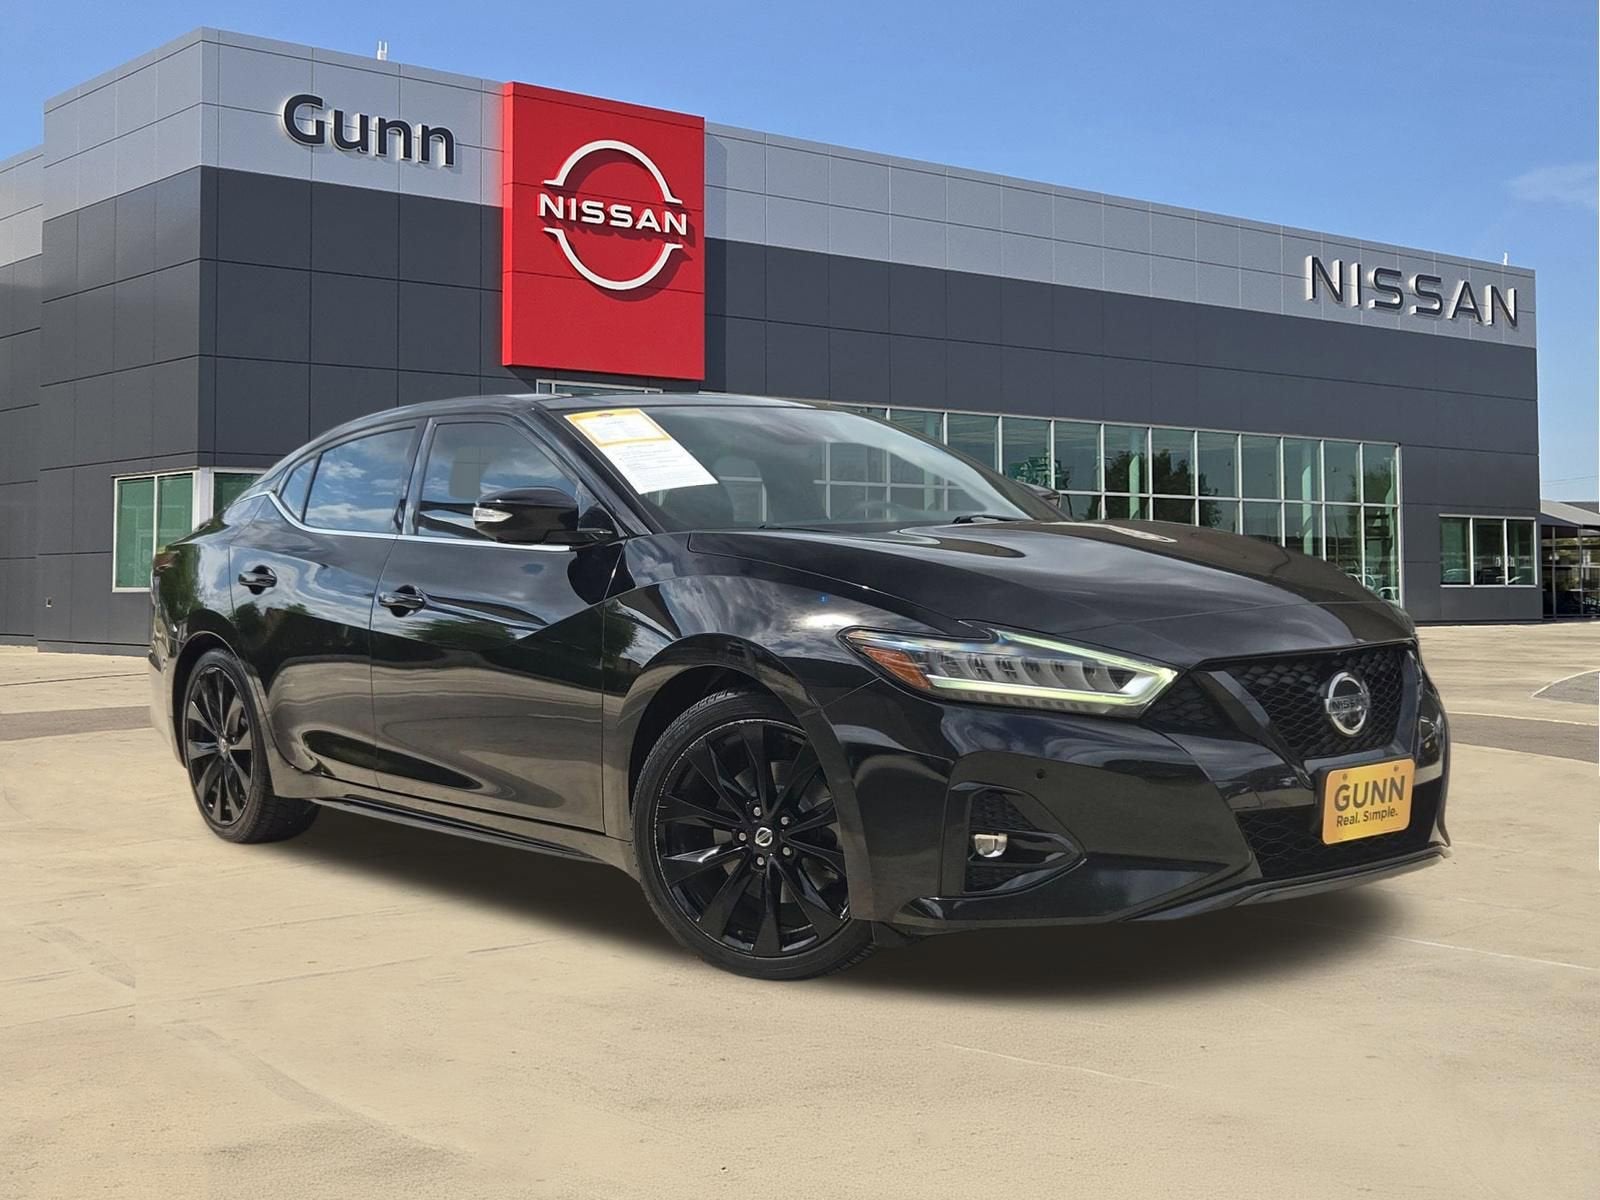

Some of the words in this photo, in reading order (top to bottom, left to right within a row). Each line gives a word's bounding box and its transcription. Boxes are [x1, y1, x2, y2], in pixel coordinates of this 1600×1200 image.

[283, 93, 456, 167] Gunn
[537, 193, 687, 236] NISSAN
[1305, 255, 1518, 327] NISSAN
[1334, 776, 1405, 812] GUNN
[1336, 813, 1360, 828] Real.
[1363, 806, 1398, 822] Simple.
